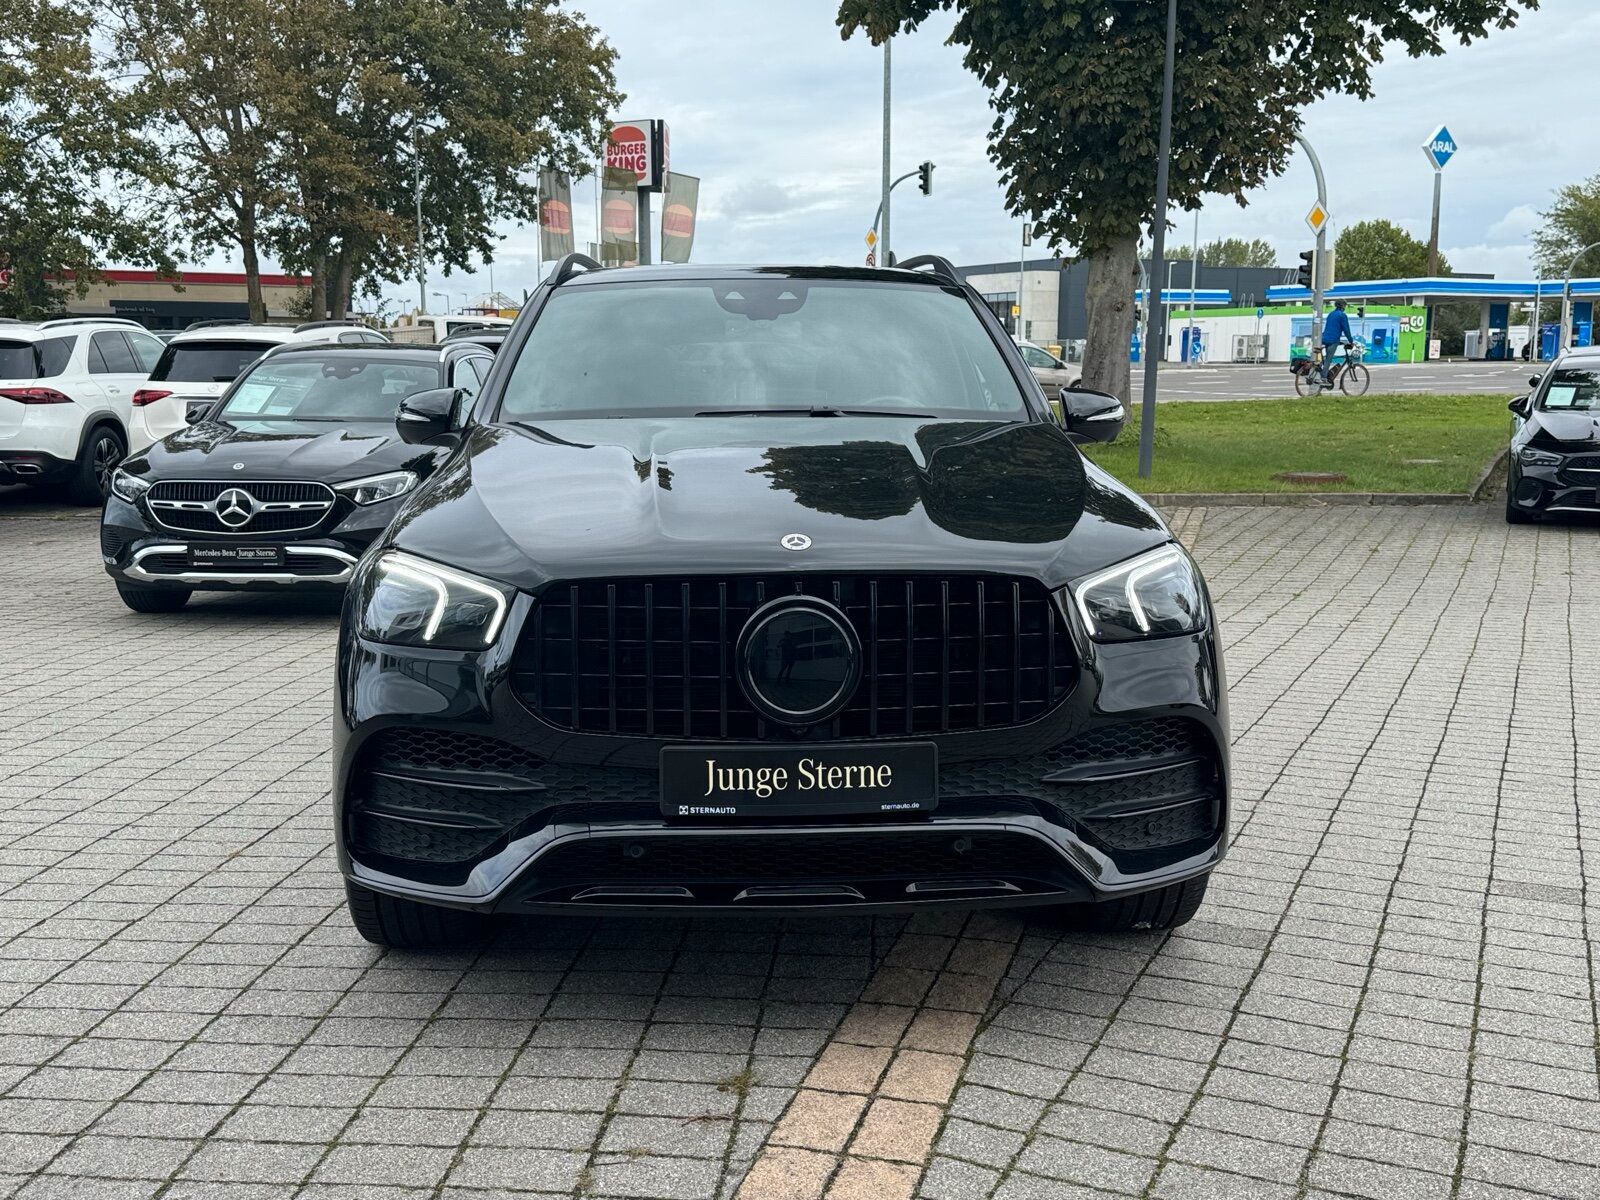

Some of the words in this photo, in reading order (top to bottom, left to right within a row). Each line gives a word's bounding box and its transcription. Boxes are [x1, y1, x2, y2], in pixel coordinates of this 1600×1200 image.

[607, 143, 647, 156] BURGER
[1432, 141, 1455, 153] ARAL
[607, 155, 647, 171] KING
[1410, 316, 1424, 327] GO
[1400, 324, 1410, 333] TO
[194, 549, 236, 557] Mercedes-Benz
[238, 549, 255, 558] Junge
[704, 759, 788, 798] Junge
[797, 758, 892, 790] Sterne
[881, 802, 920, 810] sternauto.de
